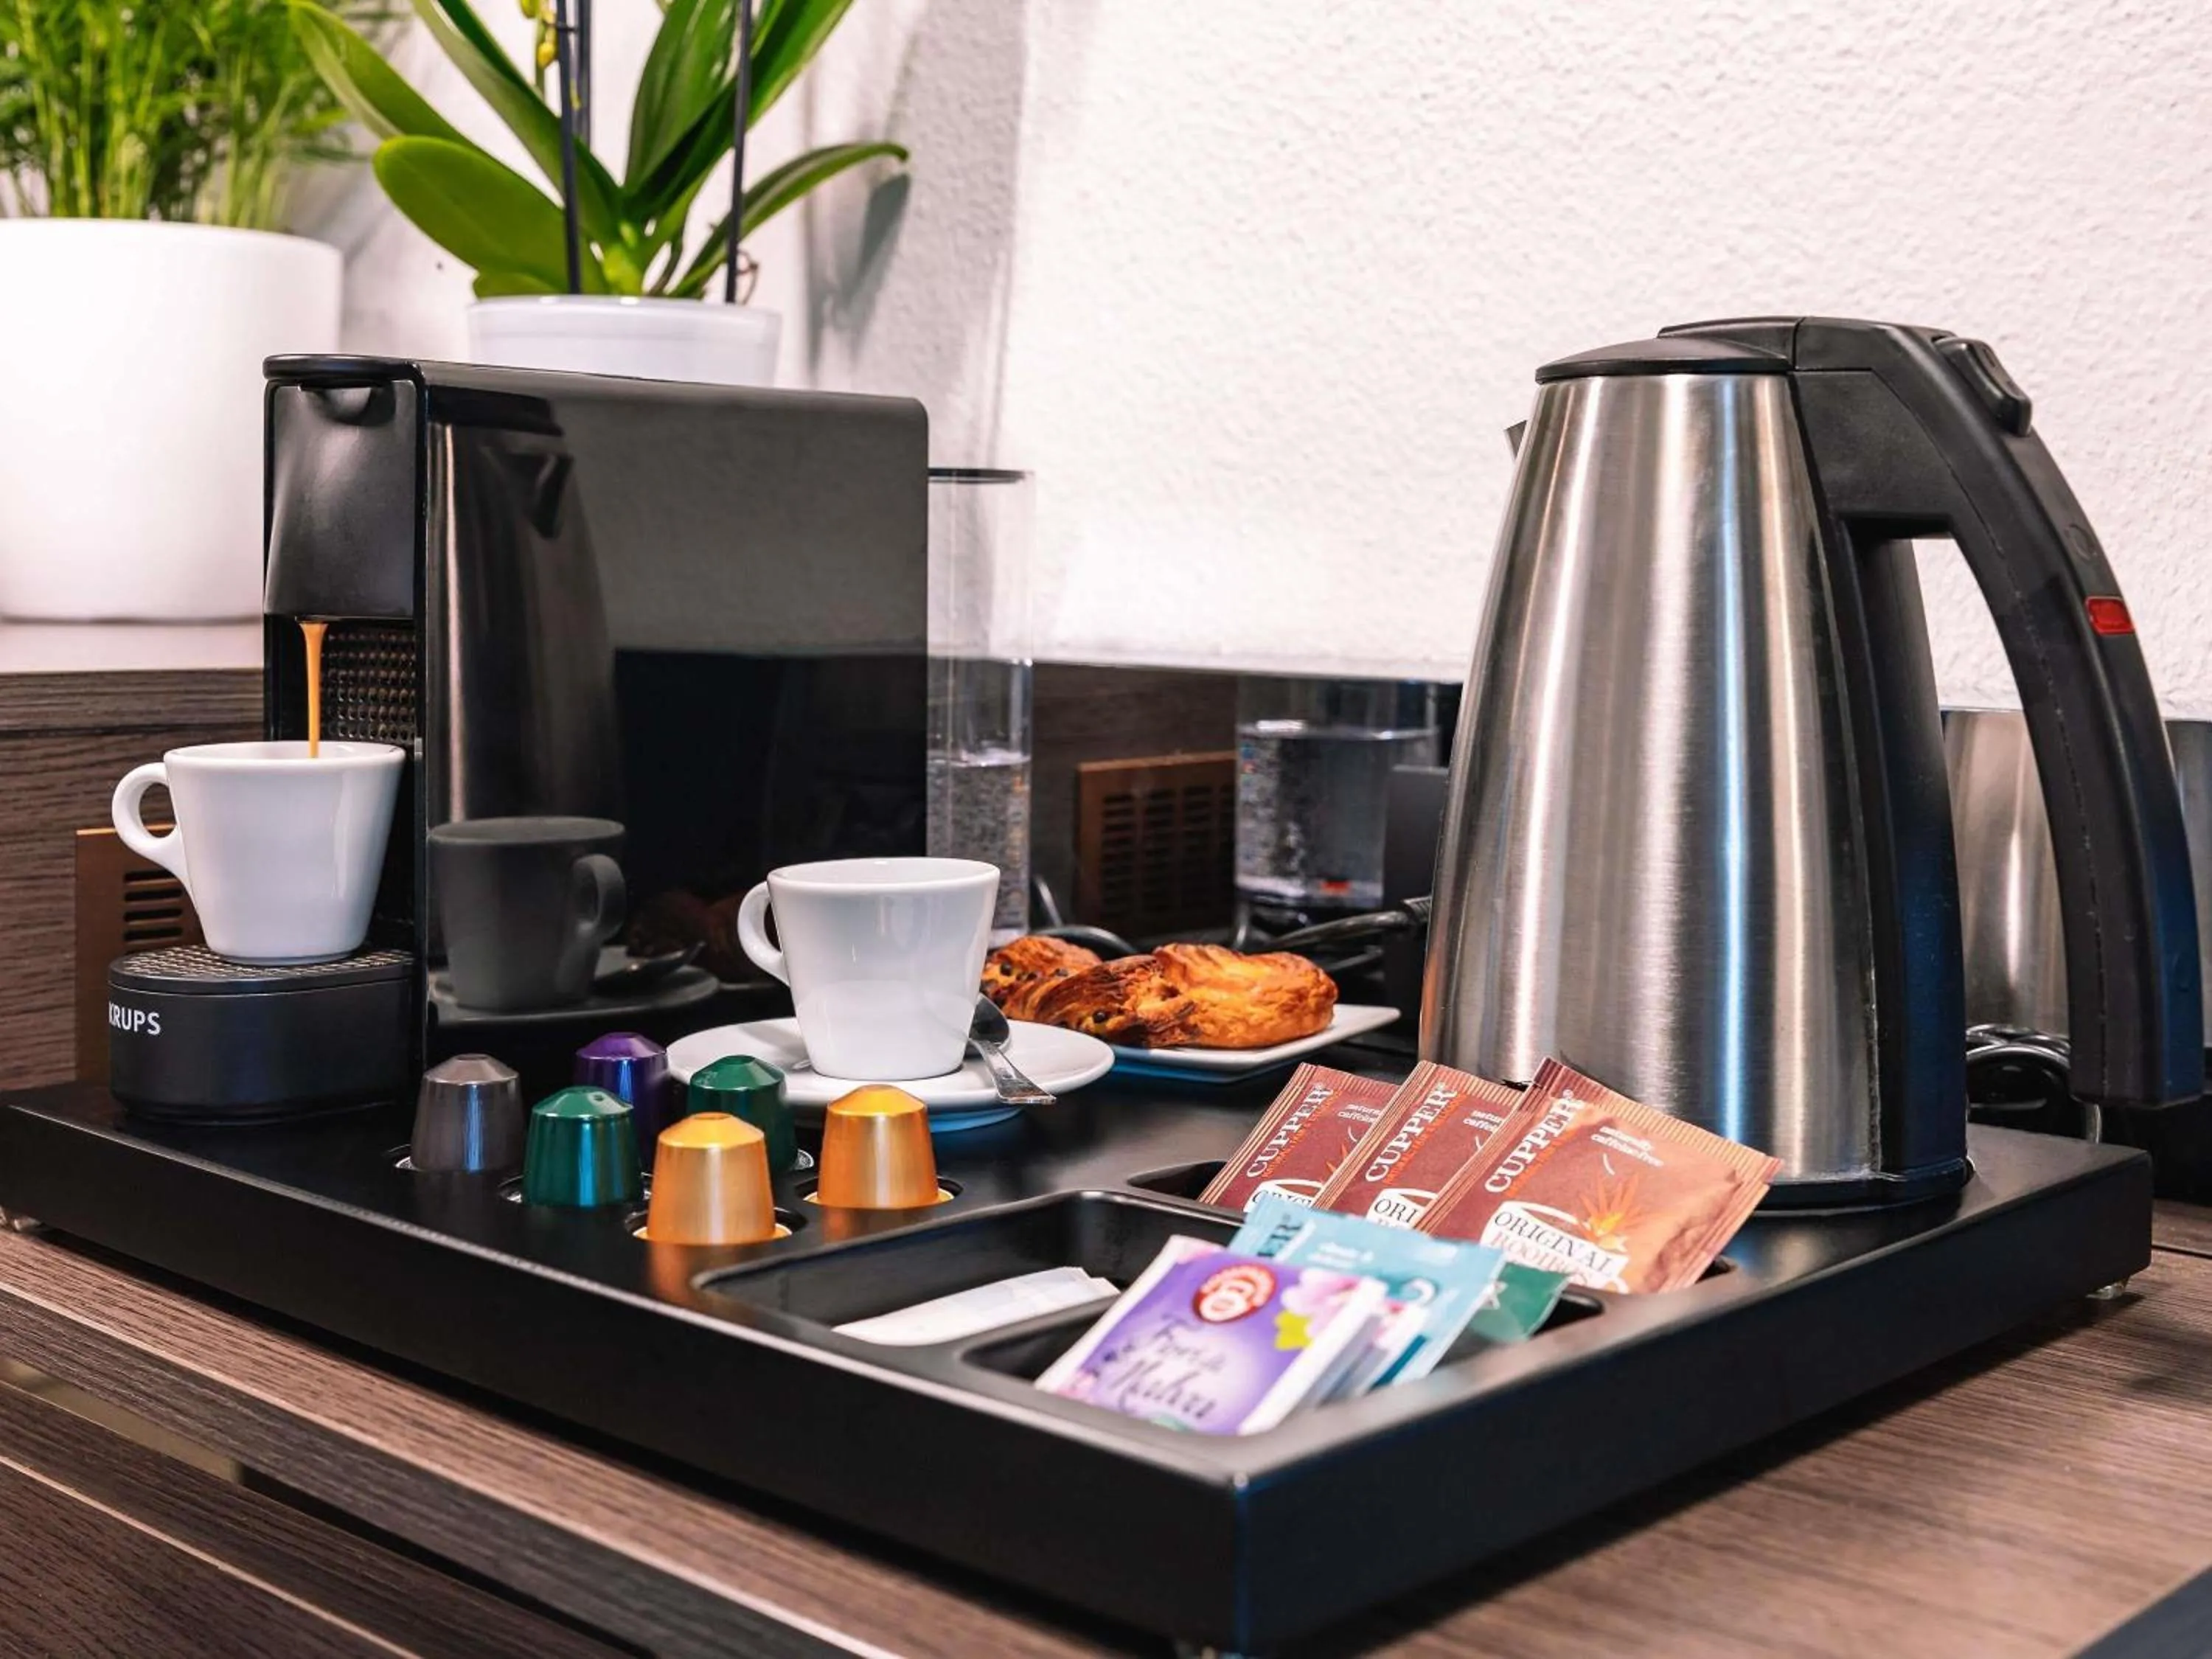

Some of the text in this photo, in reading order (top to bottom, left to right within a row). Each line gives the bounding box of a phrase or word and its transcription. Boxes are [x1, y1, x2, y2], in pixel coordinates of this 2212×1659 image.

[108, 1001, 161, 1035] KRUPS
[1246, 1087, 1334, 1178] CUPPER
[1366, 1088, 1458, 1181] CUPPER
[1484, 1097, 1585, 1192] CUPPER
[1494, 1211, 1615, 1277] ORIGINAL
